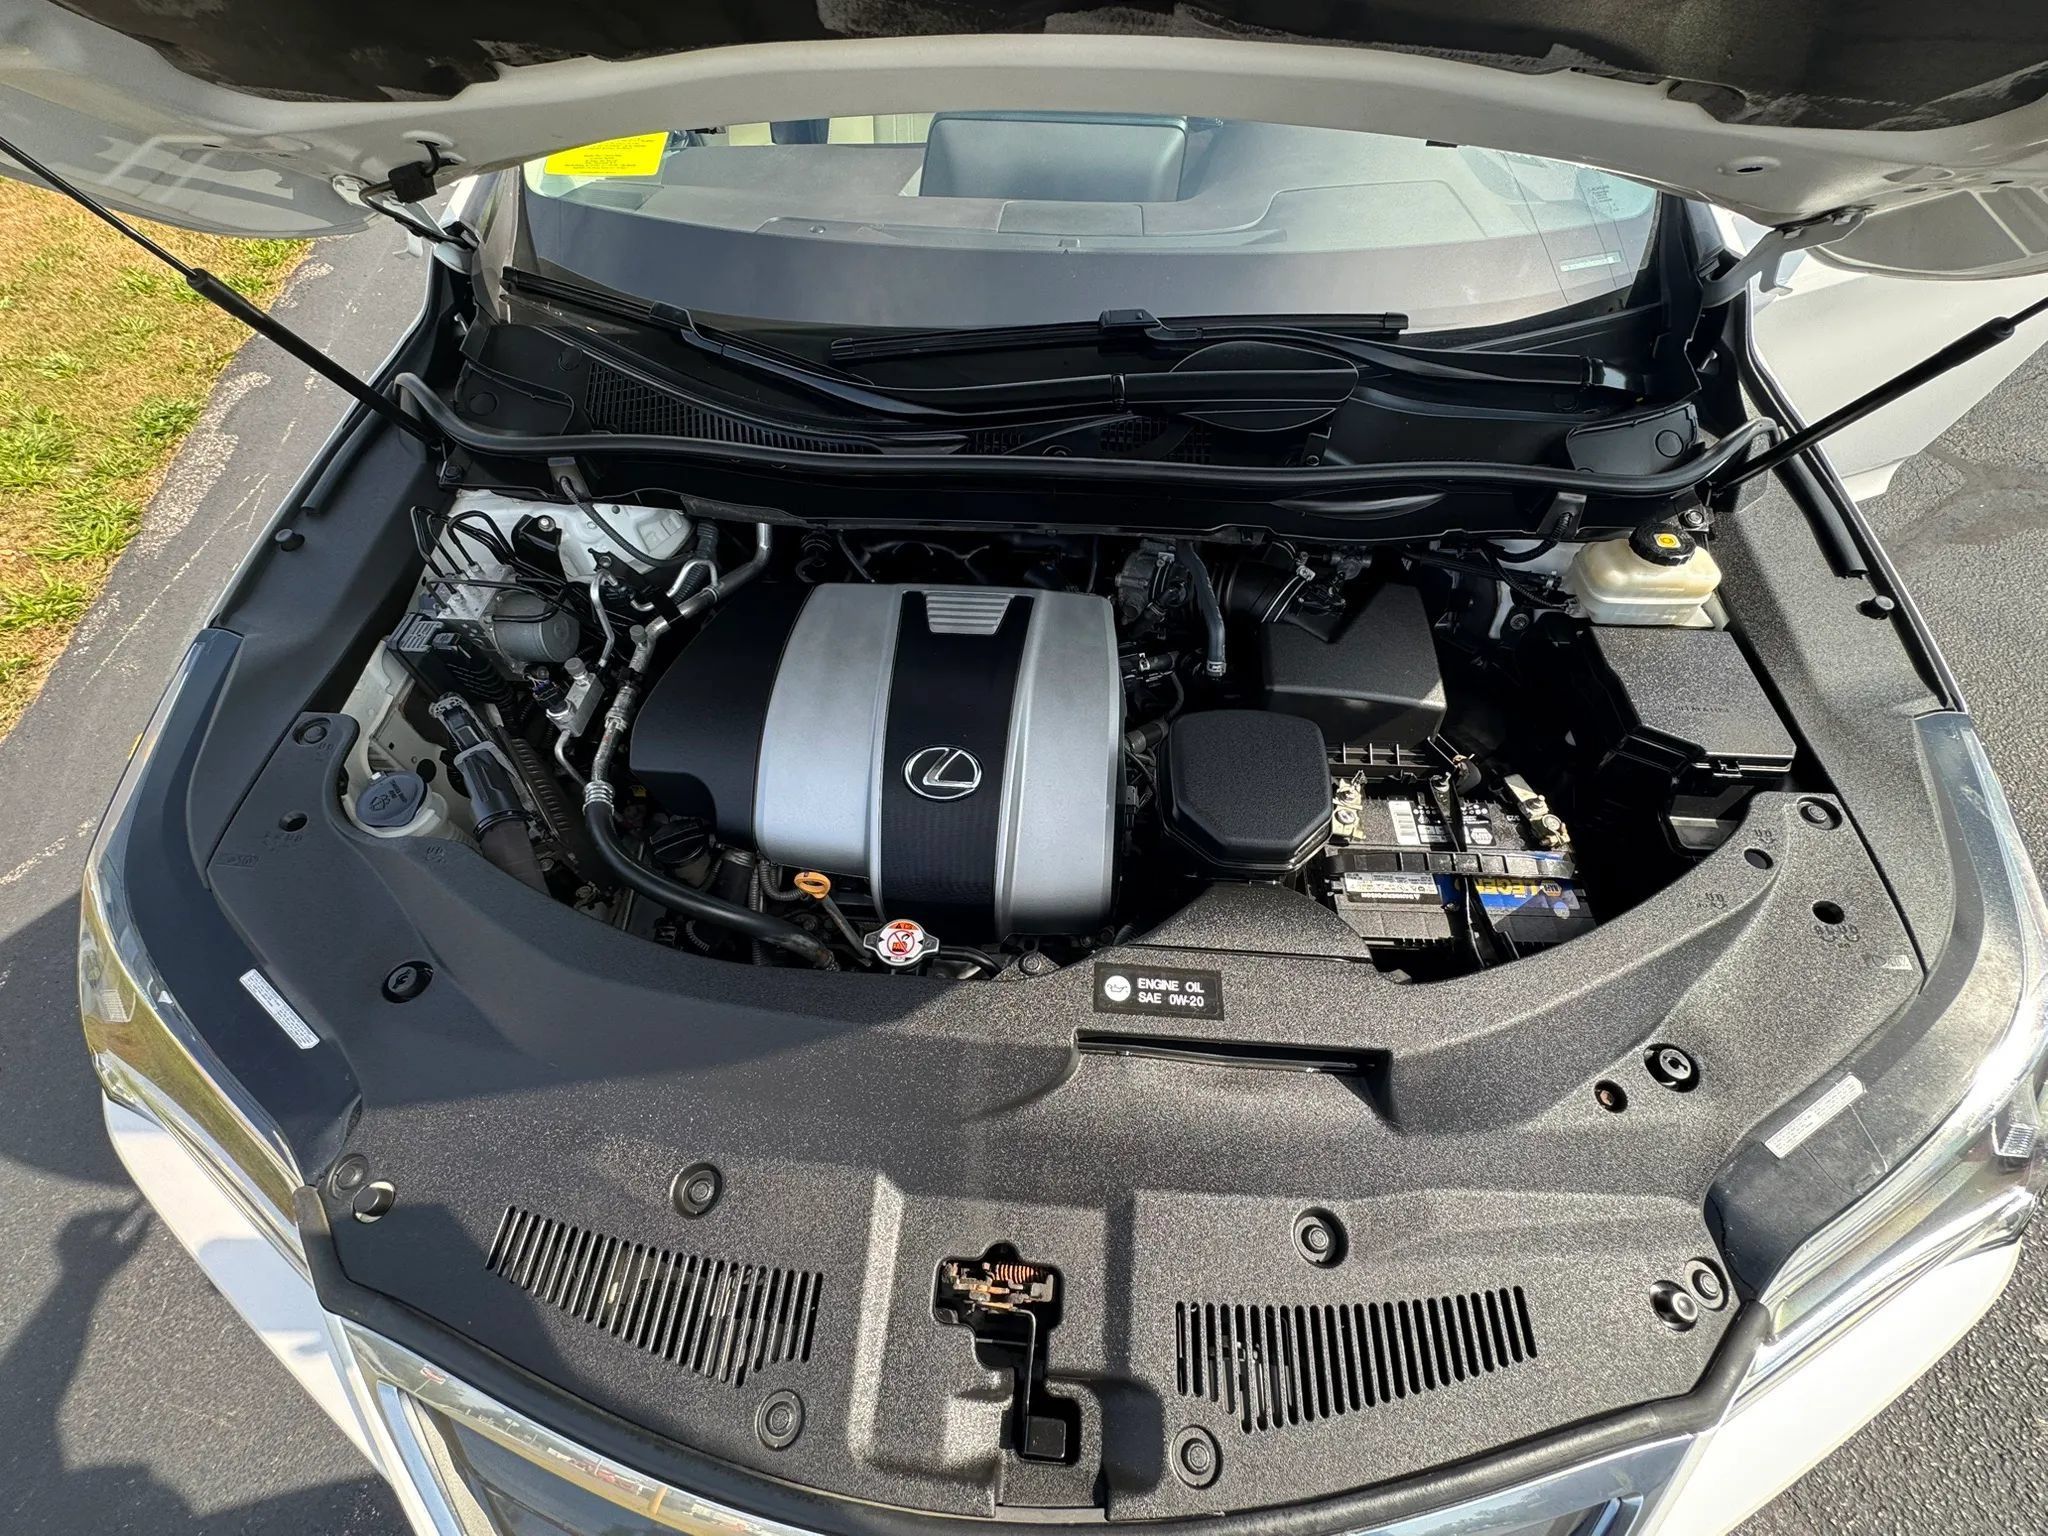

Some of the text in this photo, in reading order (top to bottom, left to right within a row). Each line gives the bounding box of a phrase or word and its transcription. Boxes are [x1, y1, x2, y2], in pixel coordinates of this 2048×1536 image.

[1137, 978, 1204, 994] ENGINE OIL
[1138, 992, 1204, 1007] SAE 0W-20
